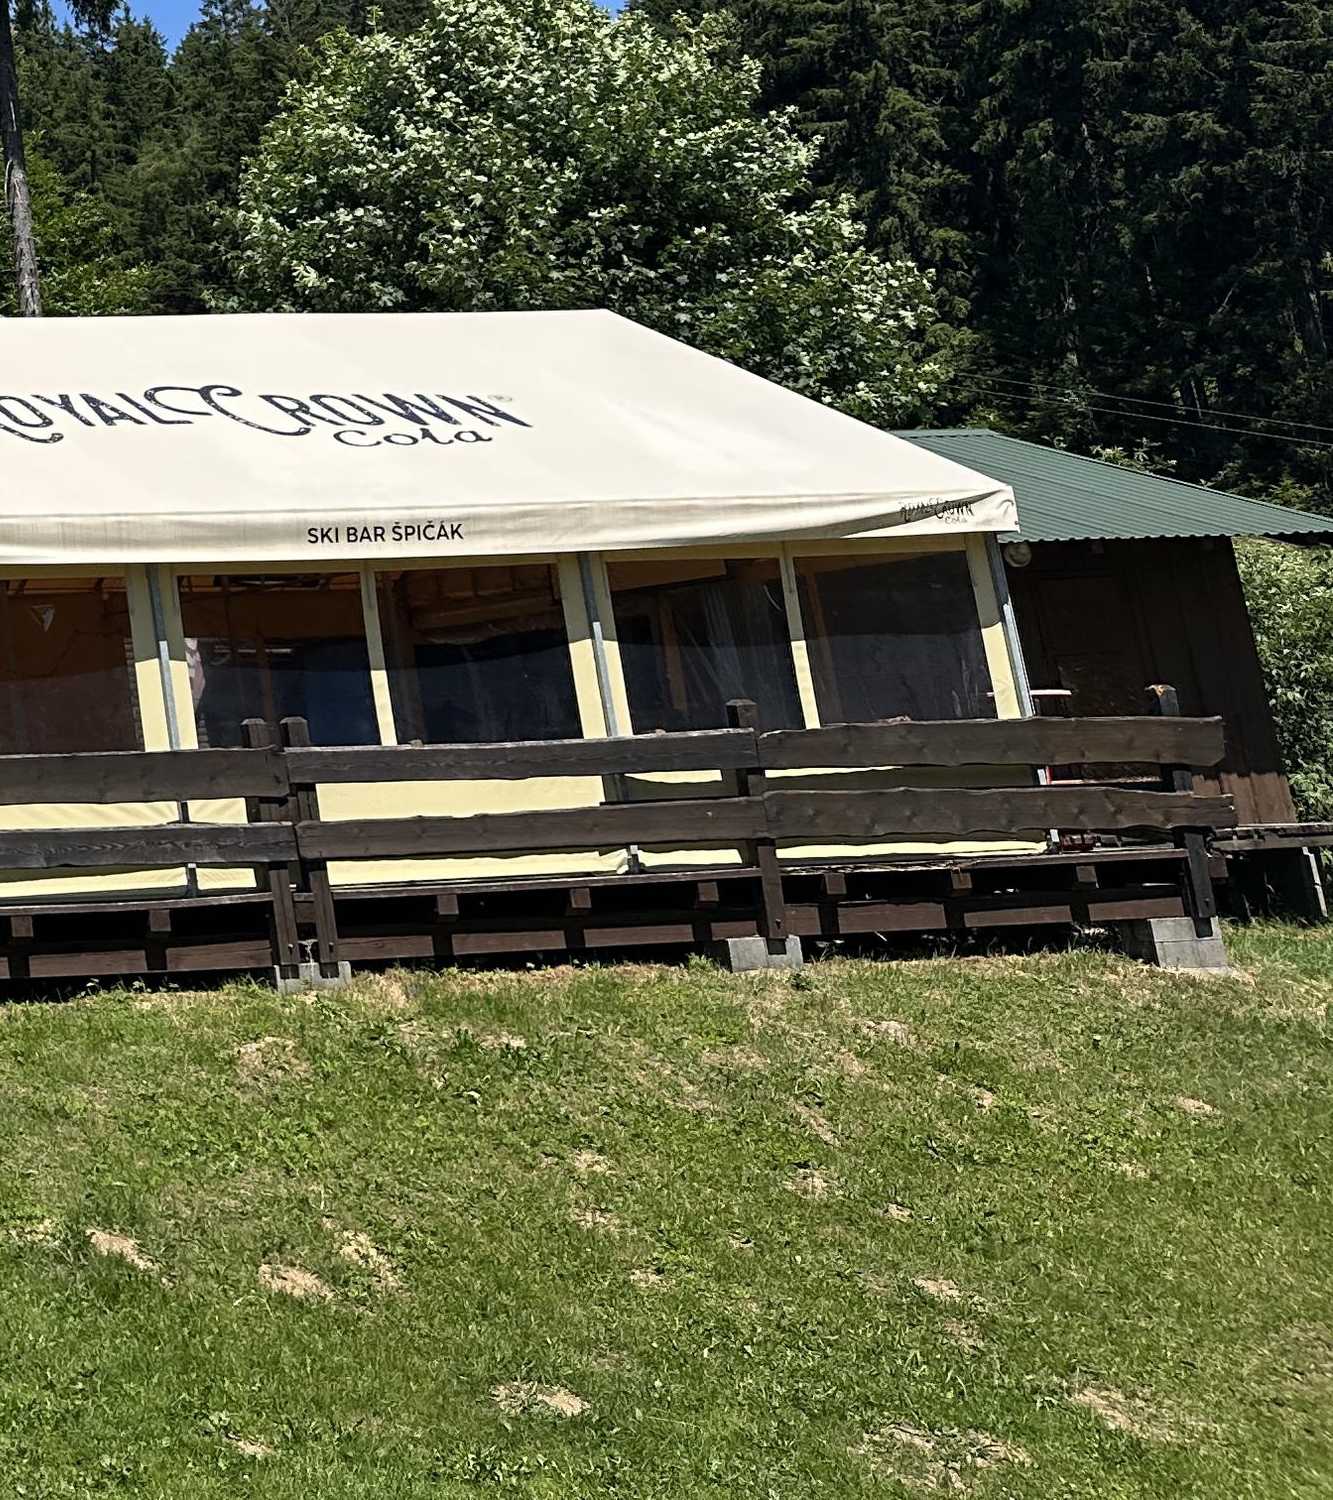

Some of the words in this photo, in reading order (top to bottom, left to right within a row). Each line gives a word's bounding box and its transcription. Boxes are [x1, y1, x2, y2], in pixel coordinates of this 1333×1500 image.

[144, 384, 533, 437] CROWN
[333, 427, 493, 447] Cola
[307, 527, 339, 544] SKI
[346, 526, 386, 543] BAR
[391, 520, 464, 542] ŠPIČÁK
